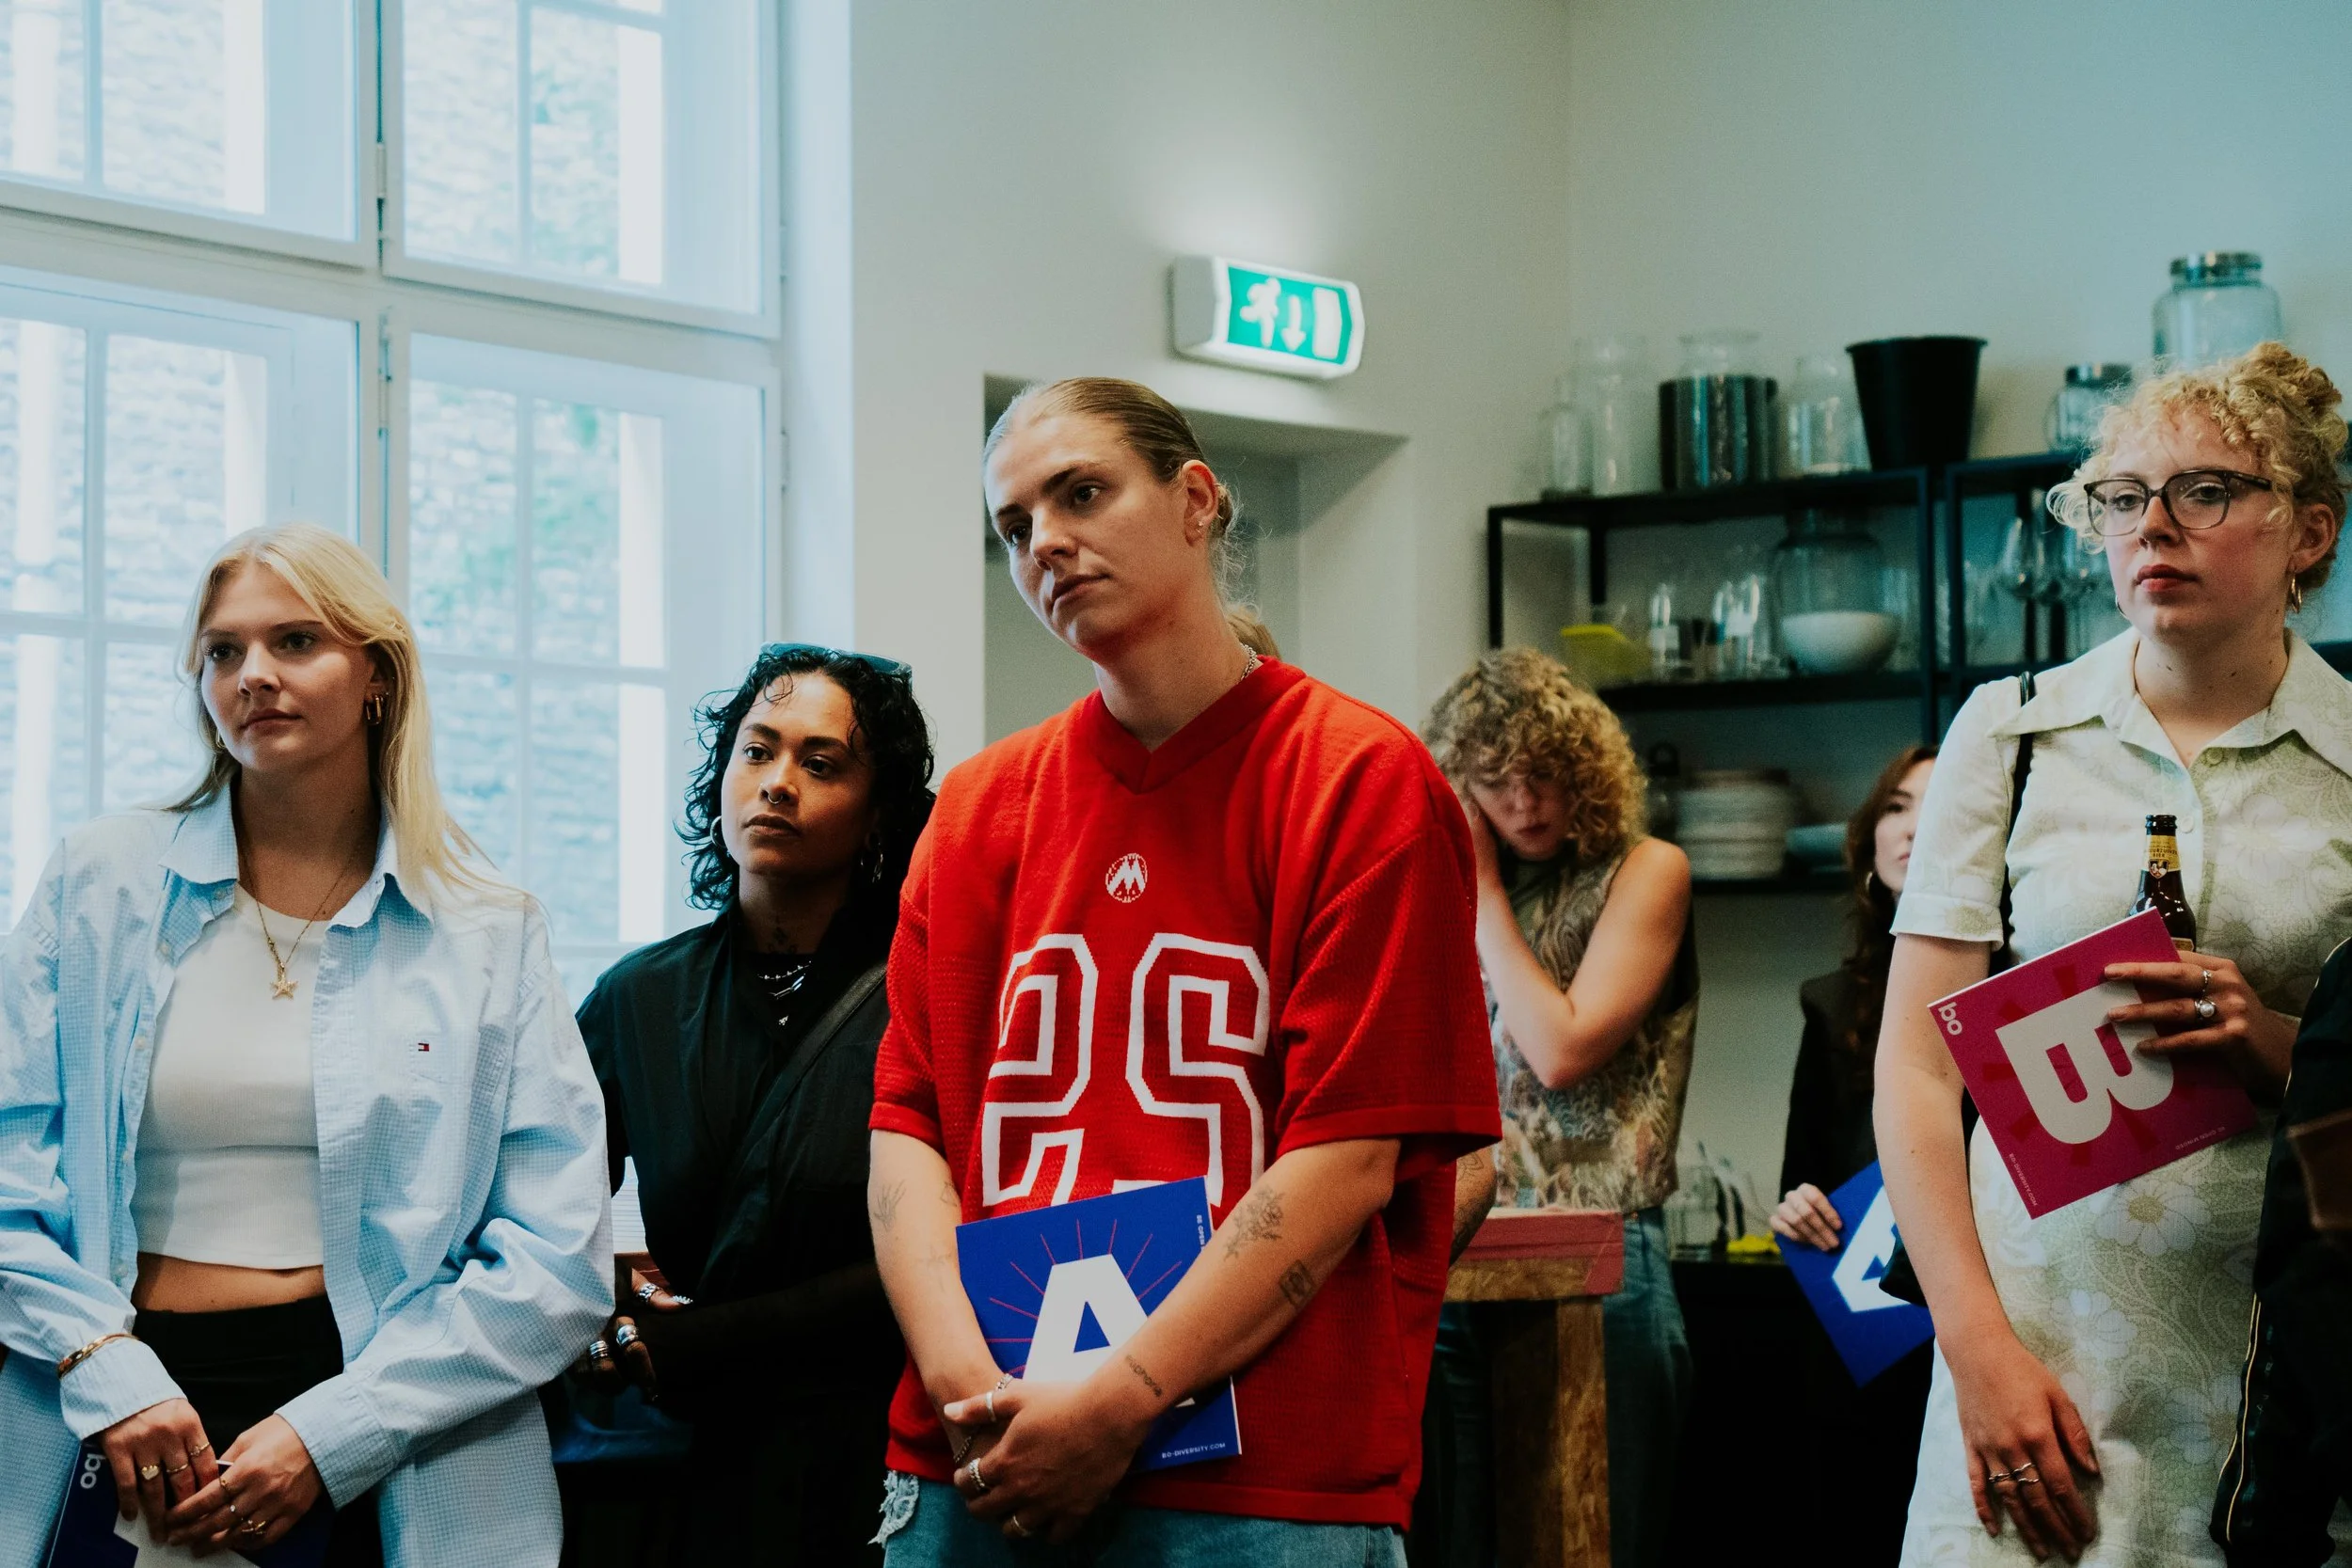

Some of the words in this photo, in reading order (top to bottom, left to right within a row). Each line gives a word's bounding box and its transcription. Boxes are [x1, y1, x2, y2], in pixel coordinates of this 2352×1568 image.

[1938, 1002, 1963, 1036] bo
[1995, 980, 2174, 1145] B
[982, 933, 1270, 1207] 25
[1022, 1254, 1195, 1409] A
[80, 1453, 106, 1489] bo
[1161, 1443, 1226, 1459] BO-DIVERSITY.COM
